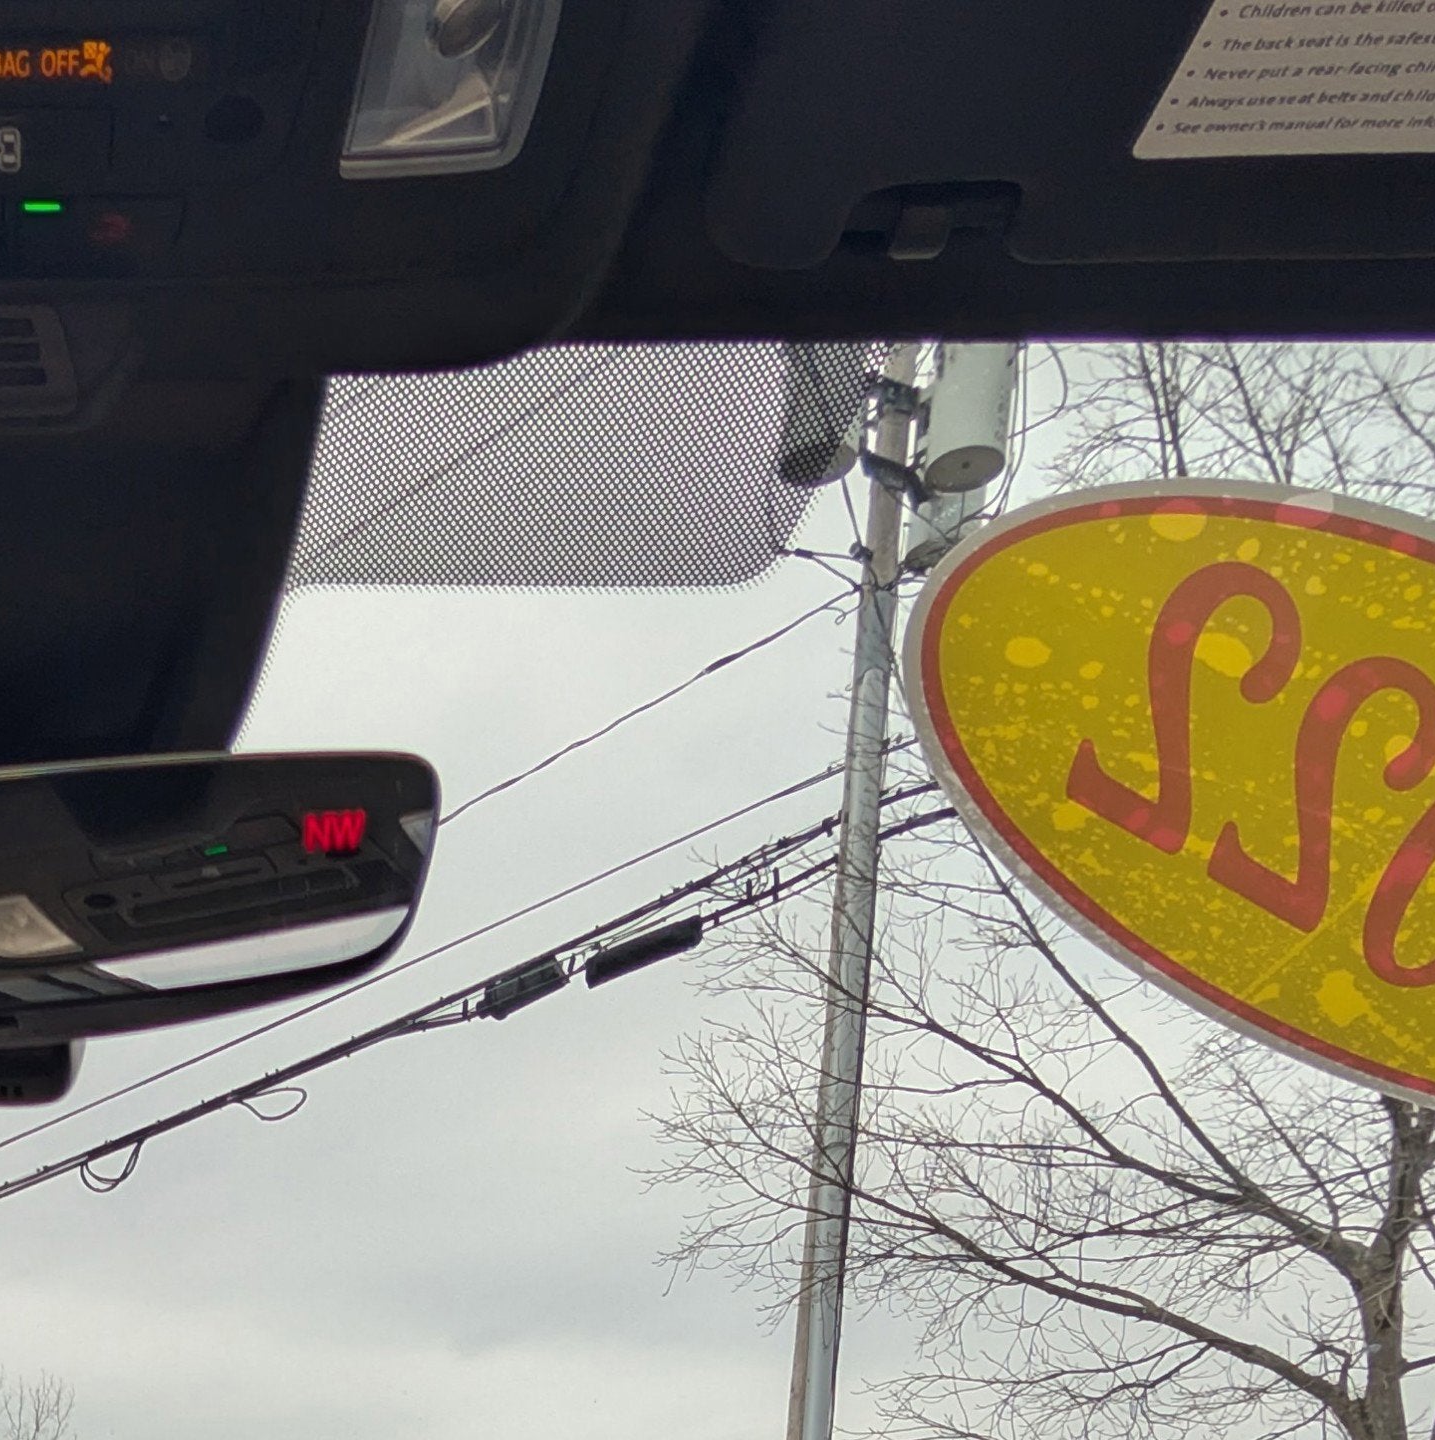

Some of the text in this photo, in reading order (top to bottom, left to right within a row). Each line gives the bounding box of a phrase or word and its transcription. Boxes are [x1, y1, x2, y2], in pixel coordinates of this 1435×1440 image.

[1239, 4, 1310, 18] Children
[1315, 4, 1344, 17] can
[1349, 1, 1372, 14] be
[1375, 0, 1422, 12] killed
[1223, 39, 1251, 50] The
[1254, 37, 1292, 50] back
[1299, 35, 1332, 47] seat
[1336, 34, 1349, 46] is
[1355, 33, 1383, 46] the
[40, 48, 80, 76] OFF
[1204, 68, 1253, 80] Never
[1258, 66, 1287, 82] put
[1292, 68, 1302, 78] a
[1187, 97, 1243, 110] Always
[1247, 97, 1277, 106] use
[1279, 94, 1314, 104] seat
[1317, 92, 1356, 103] belts
[1359, 90, 1392, 102] and
[1173, 121, 1201, 133] See
[1269, 118, 1331, 130] manual
[1333, 116, 1357, 129] for
[1361, 118, 1403, 128] more
[305, 811, 365, 851] NW
